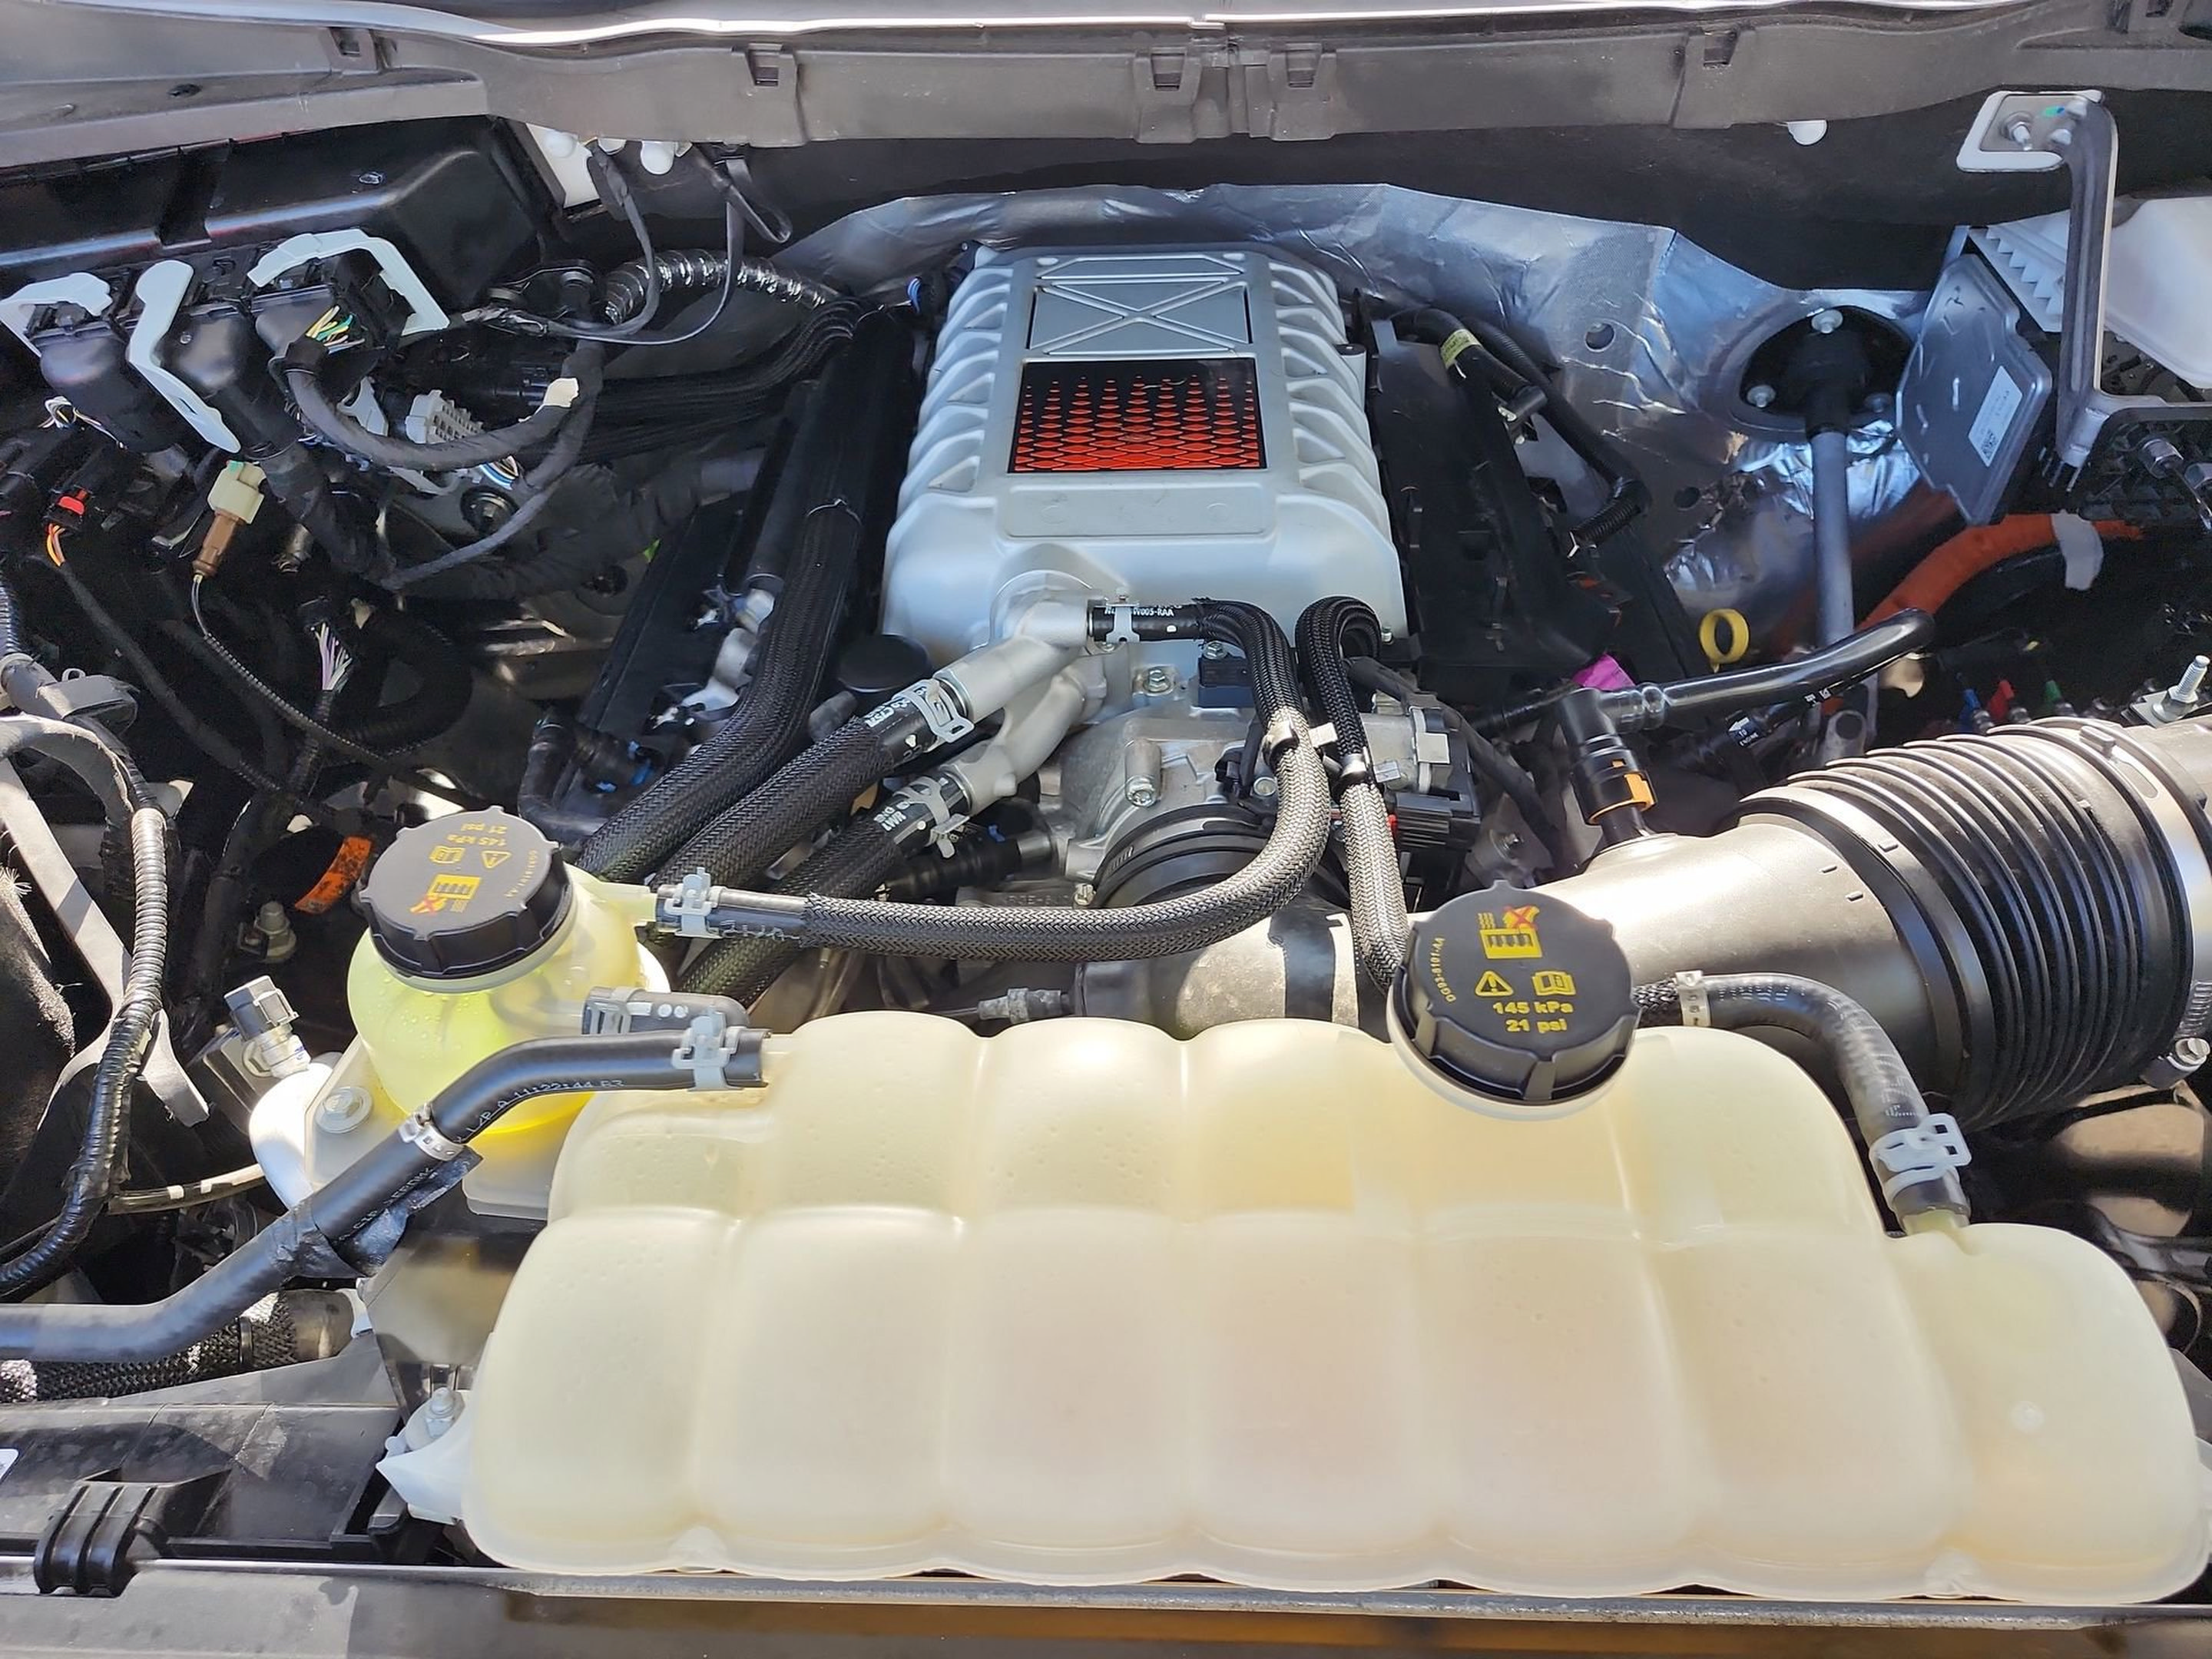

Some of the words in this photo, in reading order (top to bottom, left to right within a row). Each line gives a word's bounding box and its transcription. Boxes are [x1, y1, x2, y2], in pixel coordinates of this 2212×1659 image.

[460, 822, 485, 832] psi
[487, 824, 508, 834] 21
[445, 833, 477, 845] kPa
[478, 836, 508, 846] 145
[1492, 1001, 1531, 1015] 145
[1533, 1000, 1574, 1014] kPa
[1505, 1018, 1531, 1032] 21
[1536, 1018, 1568, 1034] psi
